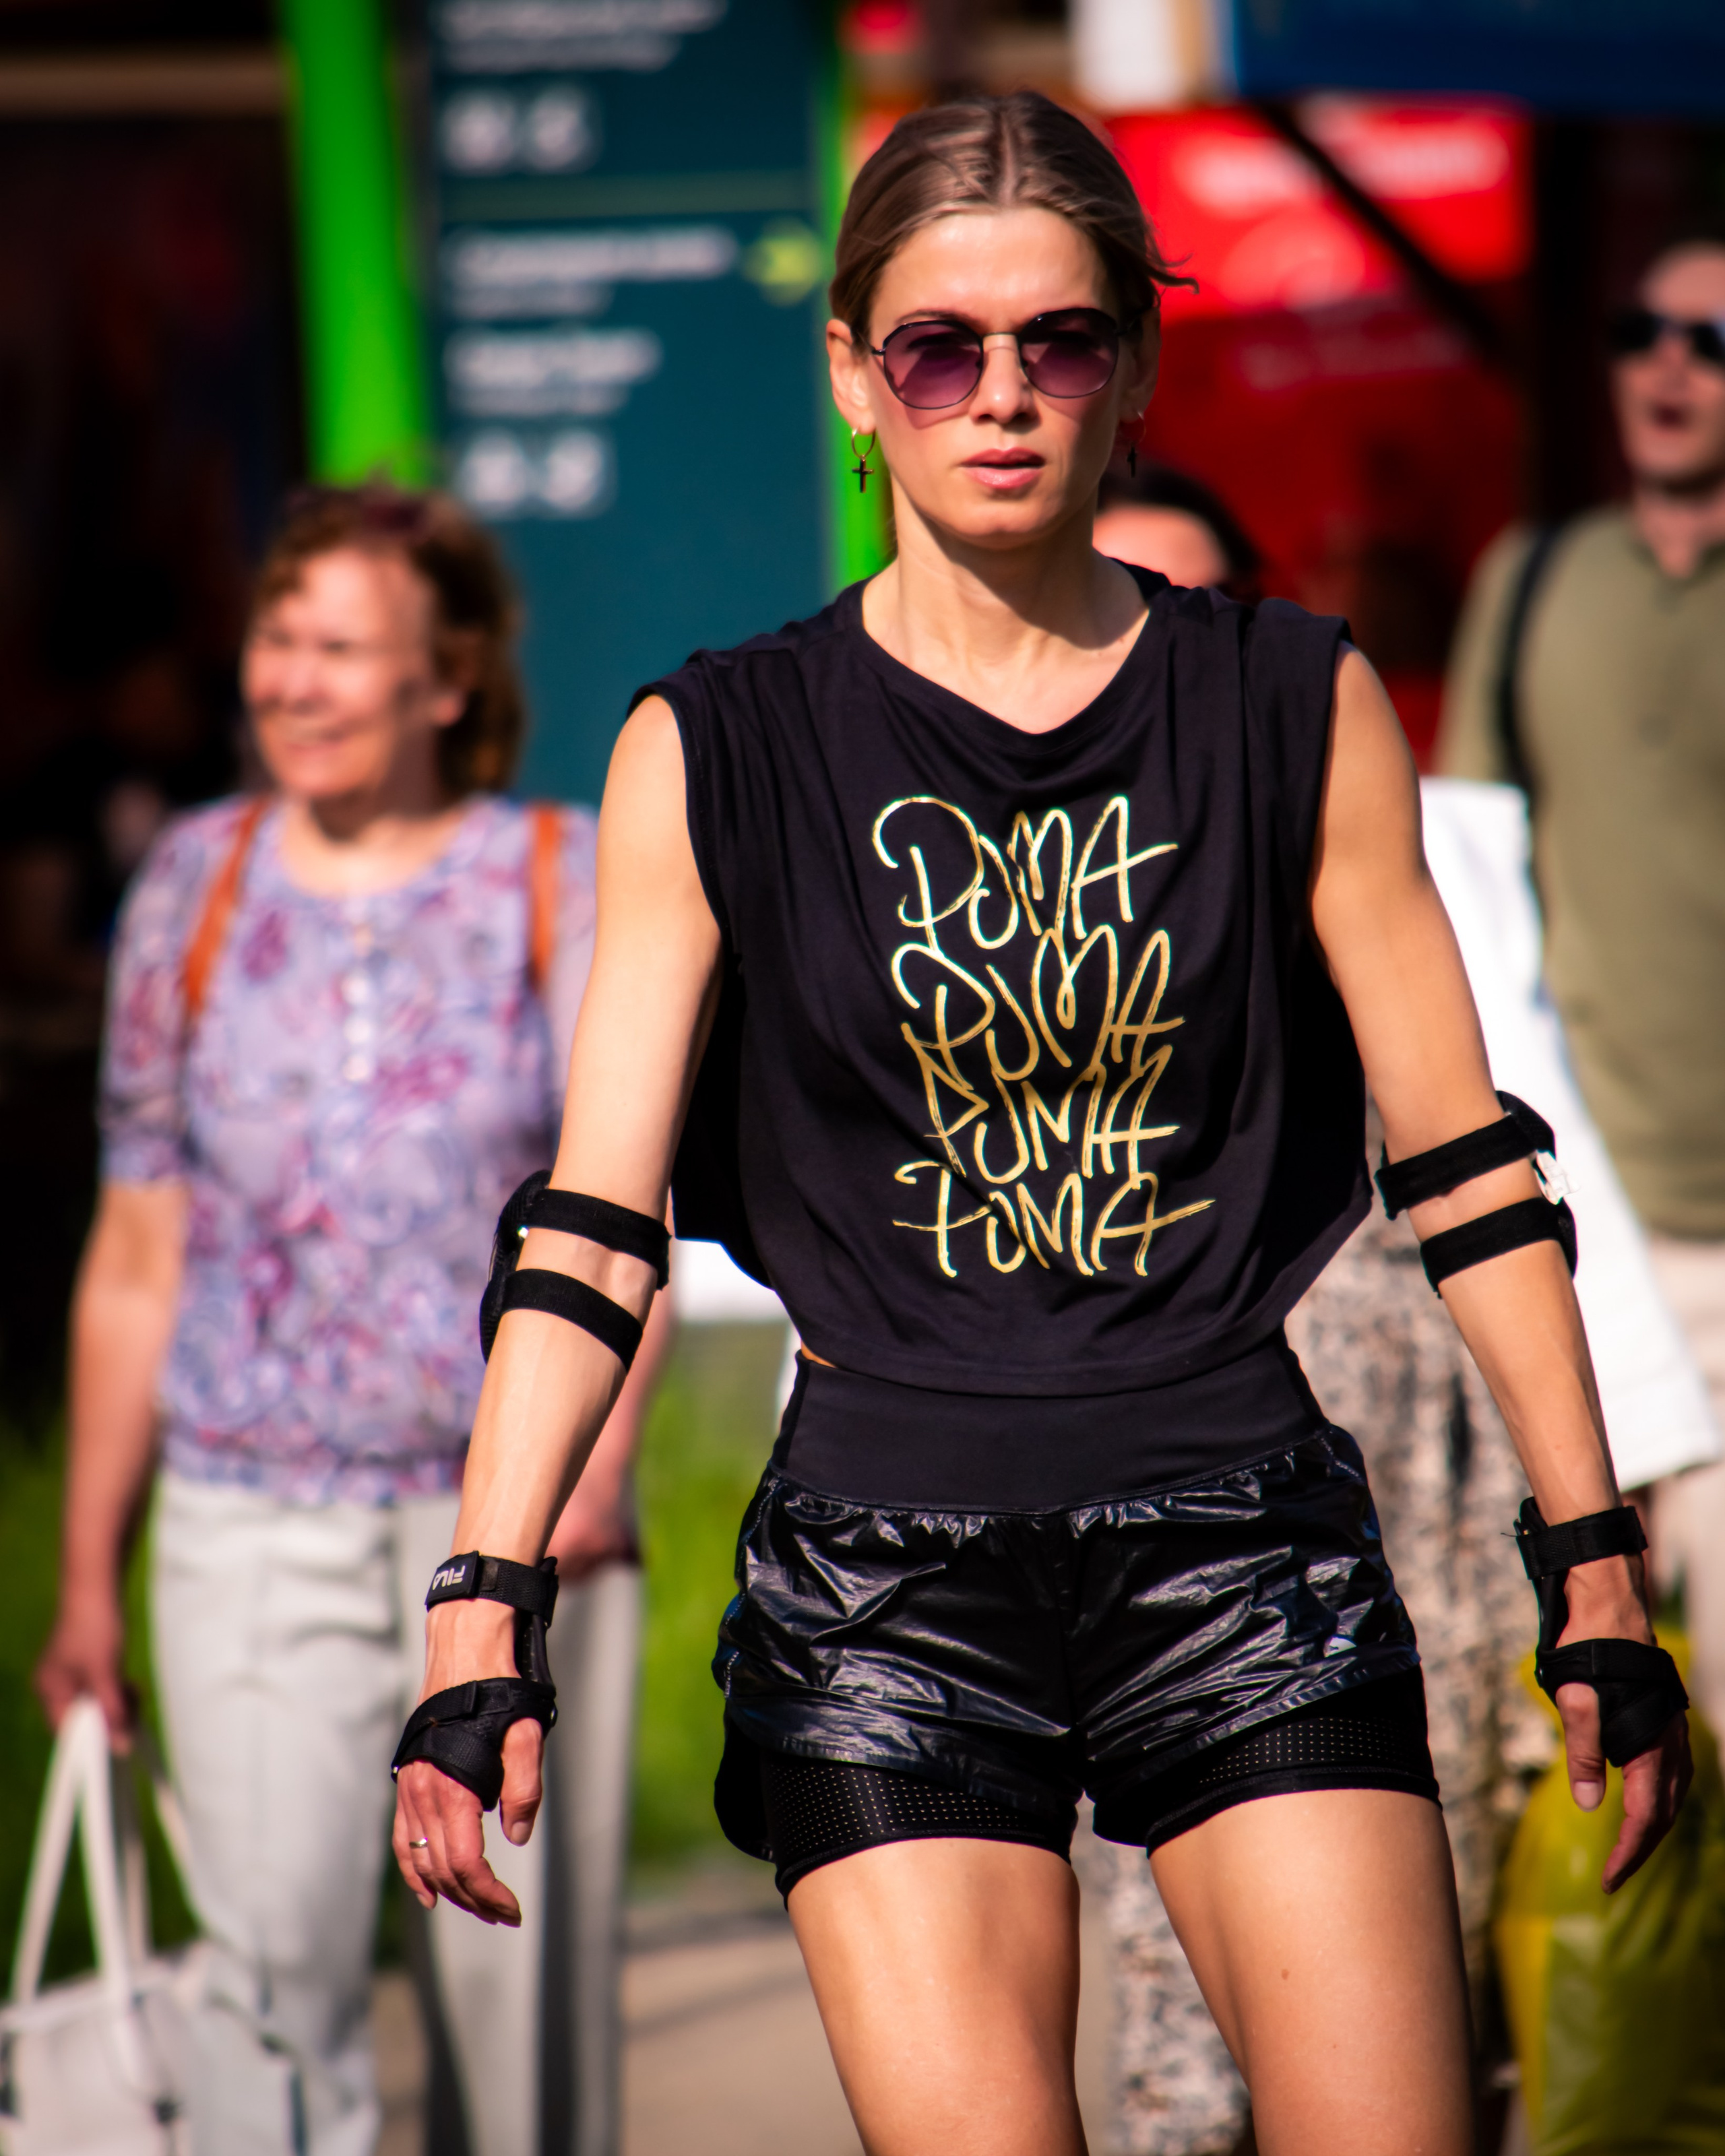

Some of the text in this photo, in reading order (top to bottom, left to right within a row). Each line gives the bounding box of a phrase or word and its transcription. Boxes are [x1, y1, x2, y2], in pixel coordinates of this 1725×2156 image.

[873, 796, 1179, 951] PUMA
[891, 925, 1186, 1090] PUMA
[901, 1044, 1181, 1190] PUMA
[893, 1172, 1216, 1277] PUMA
[433, 1565, 466, 1591] FILA
